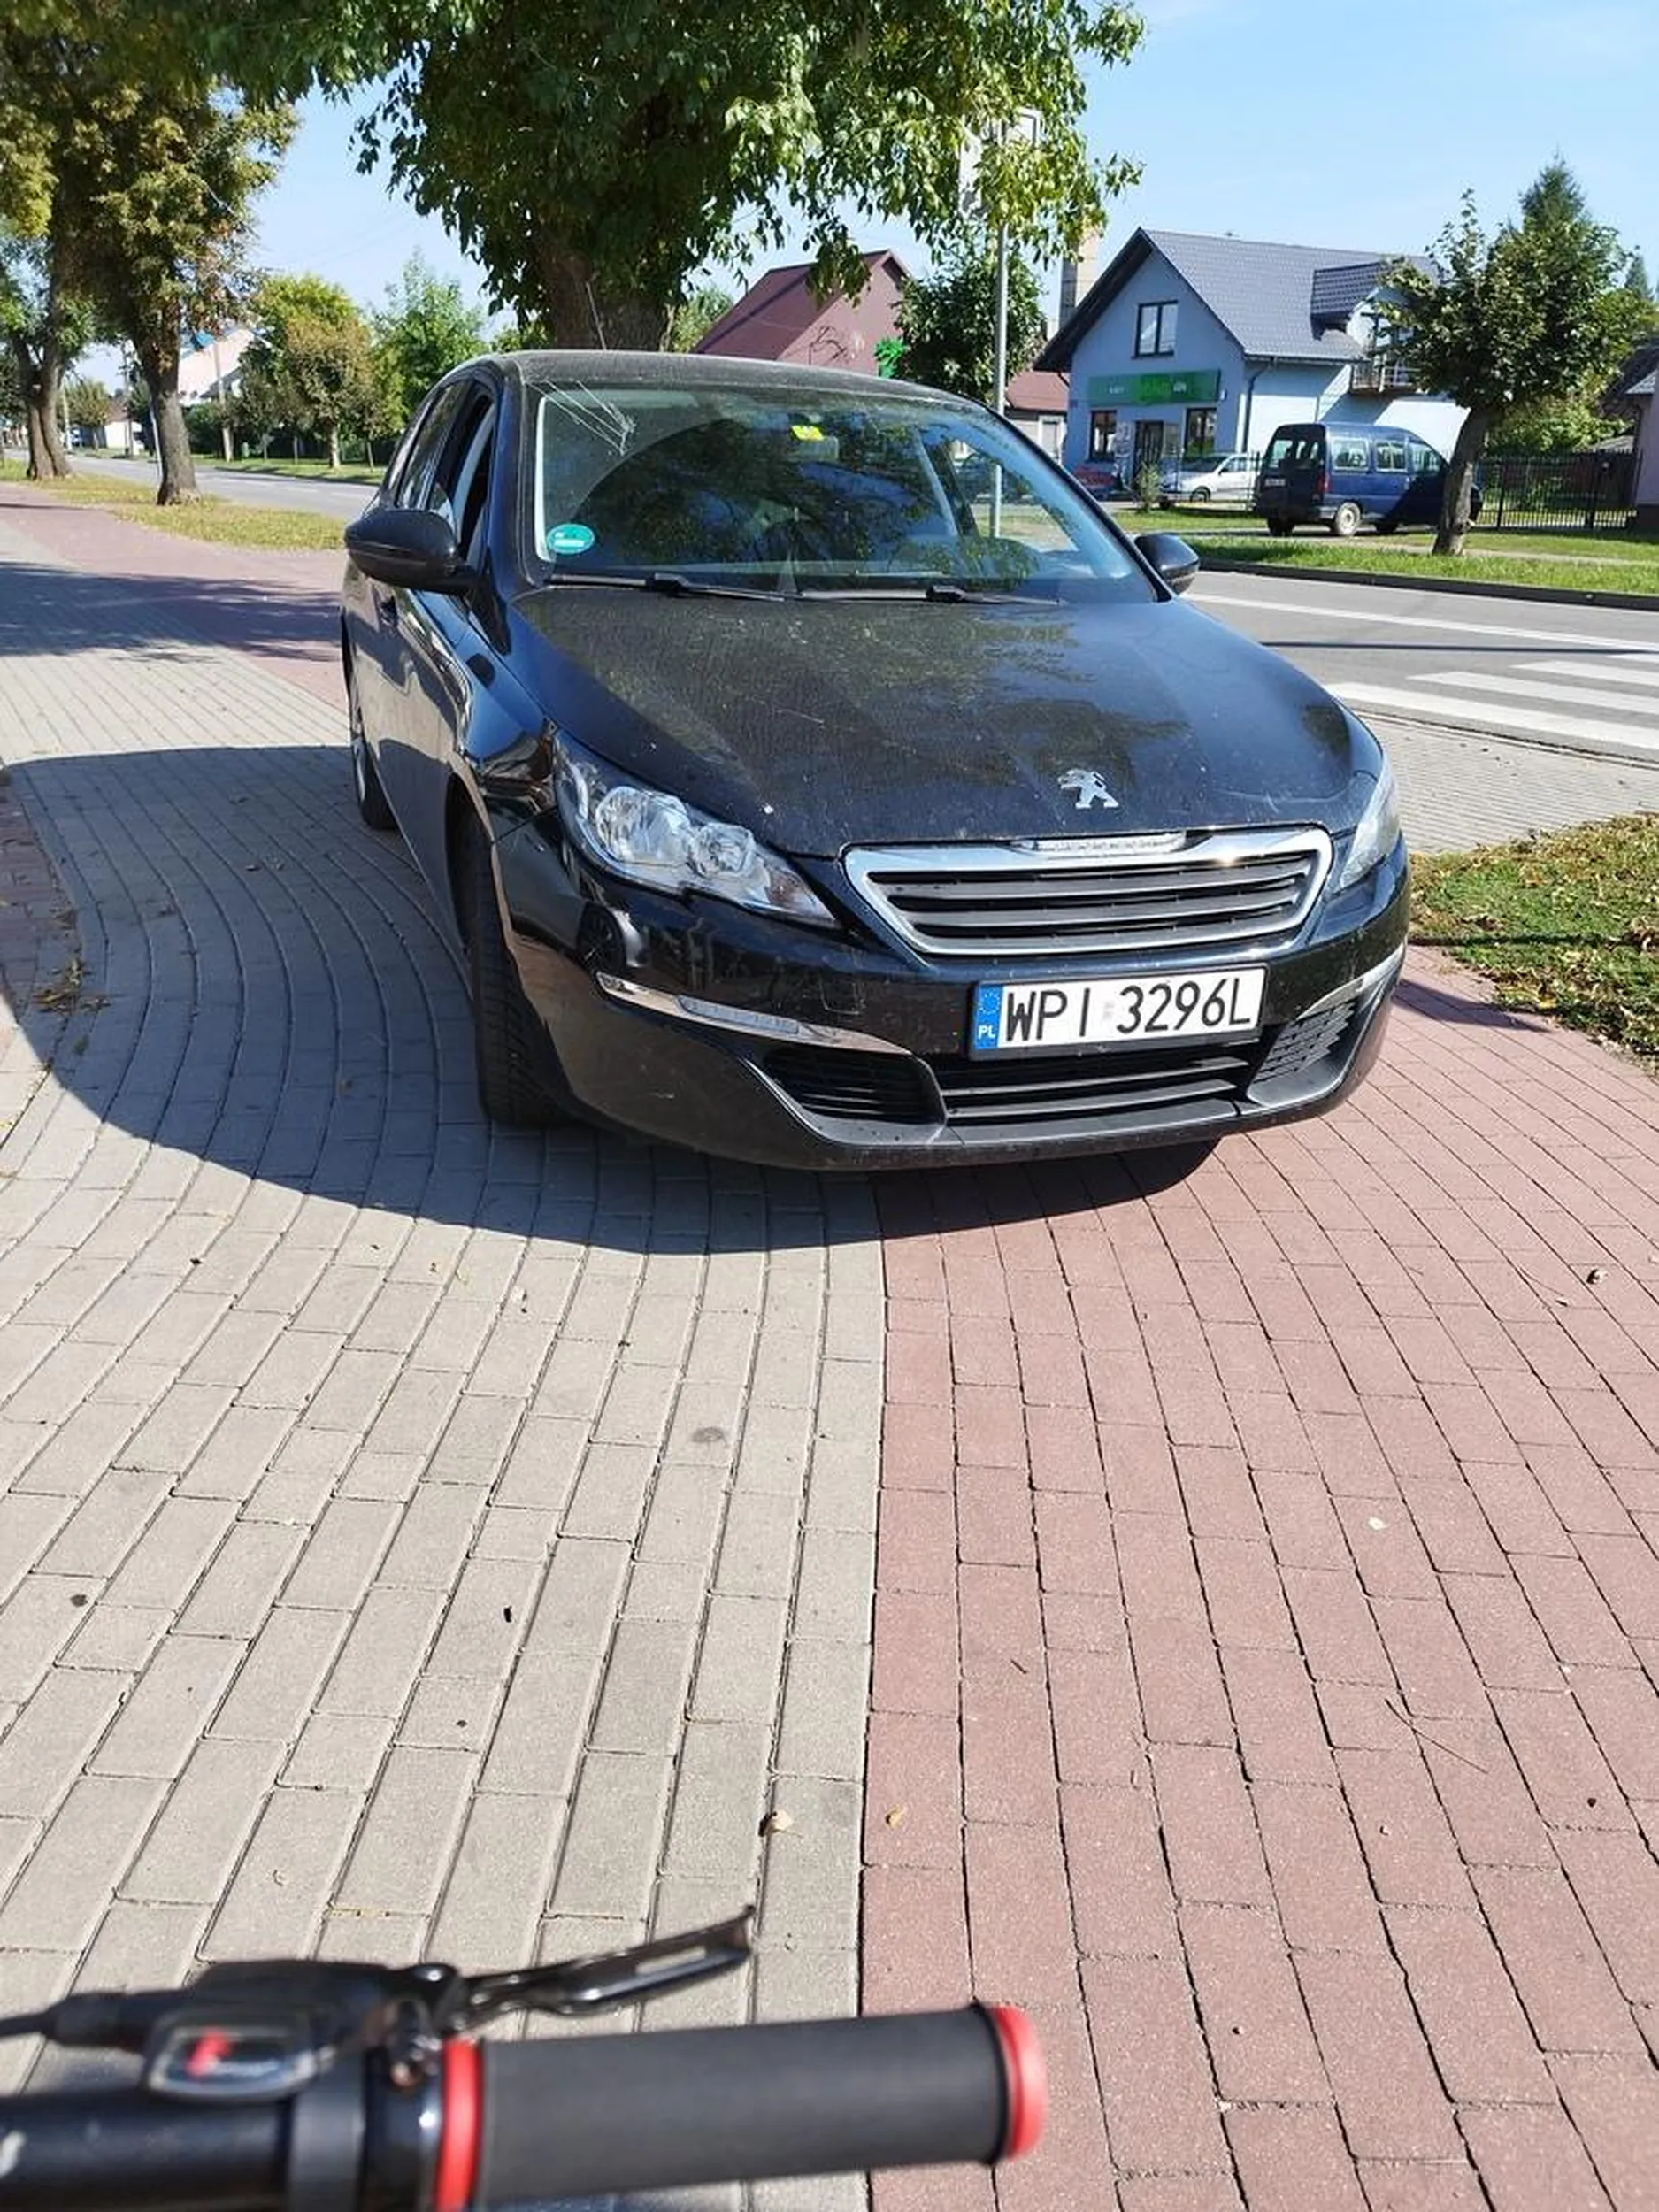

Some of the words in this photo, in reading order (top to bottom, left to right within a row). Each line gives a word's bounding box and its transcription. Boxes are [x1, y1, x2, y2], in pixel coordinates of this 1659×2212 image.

[1006, 987, 1090, 1042] WPI
[1116, 978, 1250, 1034] 3296L
[979, 1025, 995, 1039] PL
